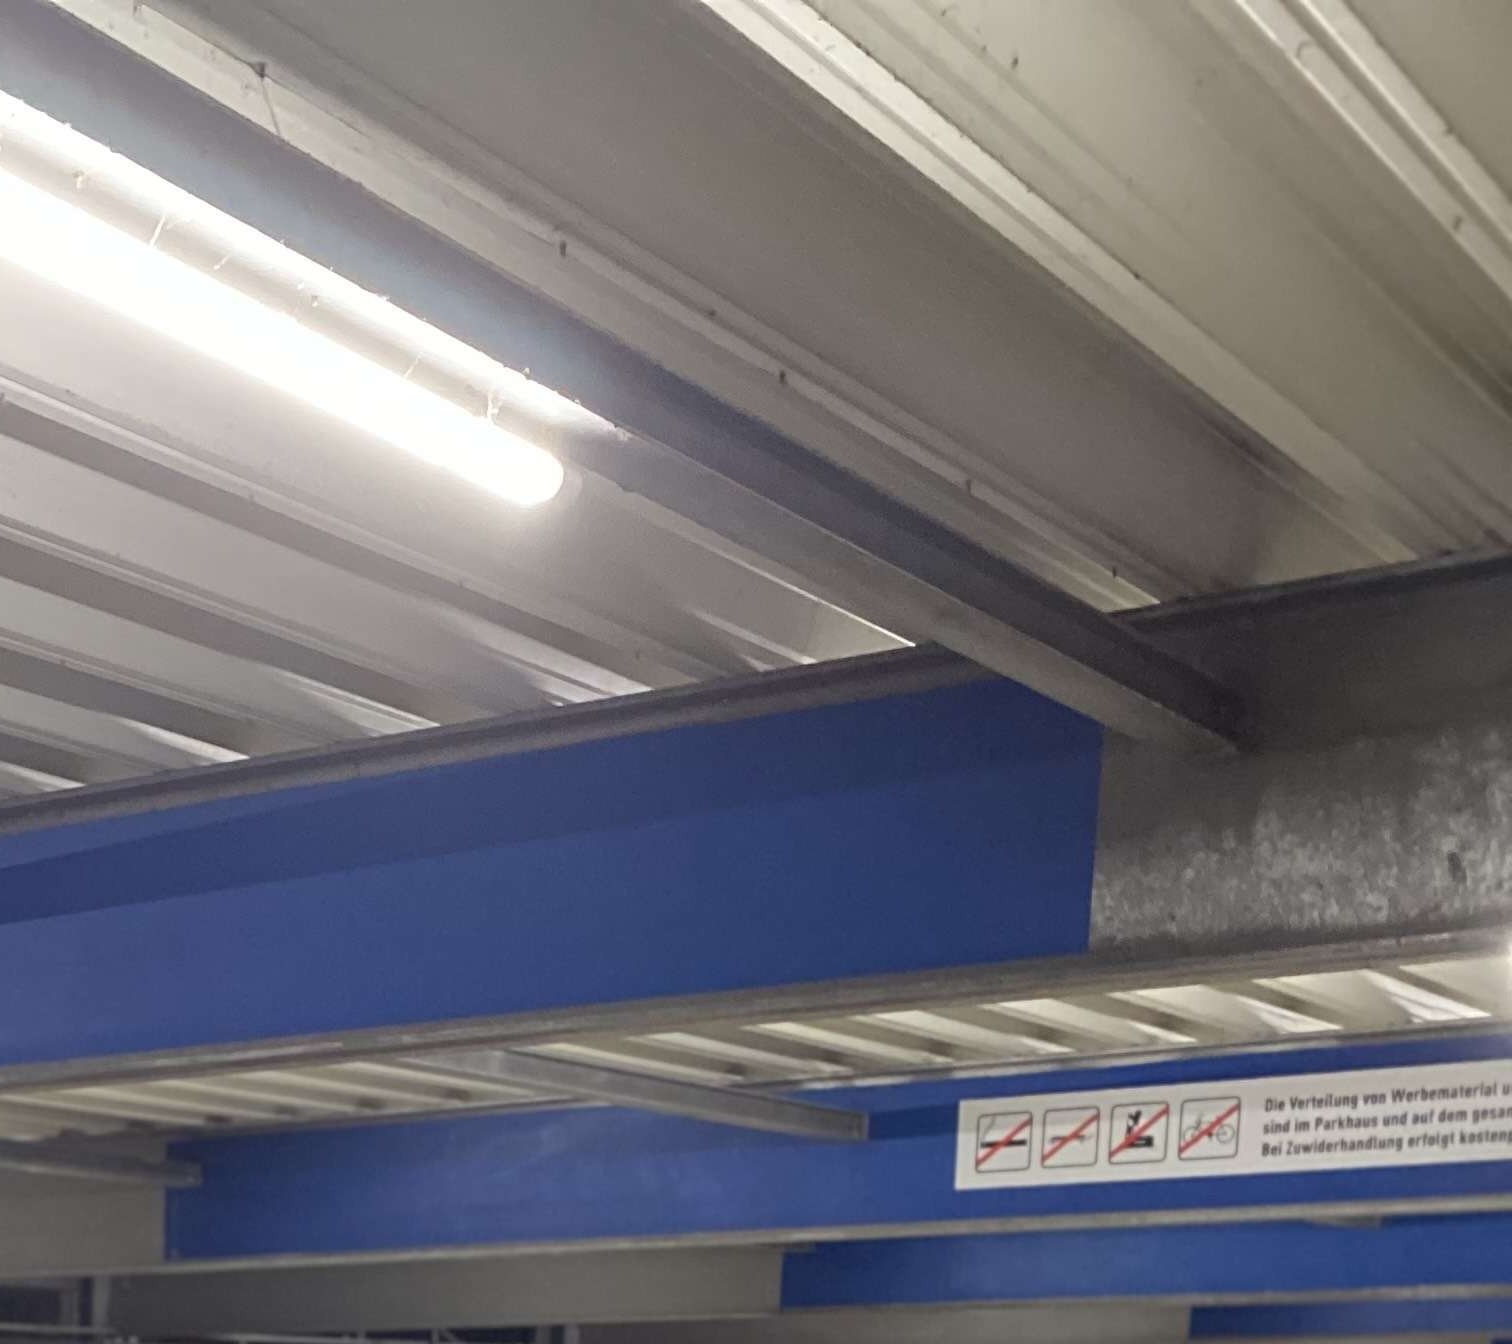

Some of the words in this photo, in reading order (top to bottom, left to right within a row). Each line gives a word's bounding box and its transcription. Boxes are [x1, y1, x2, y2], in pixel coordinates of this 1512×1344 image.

[1265, 1097, 1285, 1113] Die
[1290, 1094, 1358, 1111] Verteilung
[1363, 1091, 1387, 1106] von
[1391, 1083, 1497, 1104] Werbematerial
[1263, 1118, 1290, 1135] sind
[1295, 1118, 1310, 1133] im
[1315, 1114, 1378, 1132] Parkhaus
[1383, 1111, 1408, 1127] und
[1412, 1109, 1435, 1124] auf
[1439, 1107, 1468, 1123] dem
[1262, 1142, 1283, 1157] Bei
[1286, 1134, 1403, 1156] Zuwiderhandlung
[1408, 1131, 1455, 1149] erfolgt
